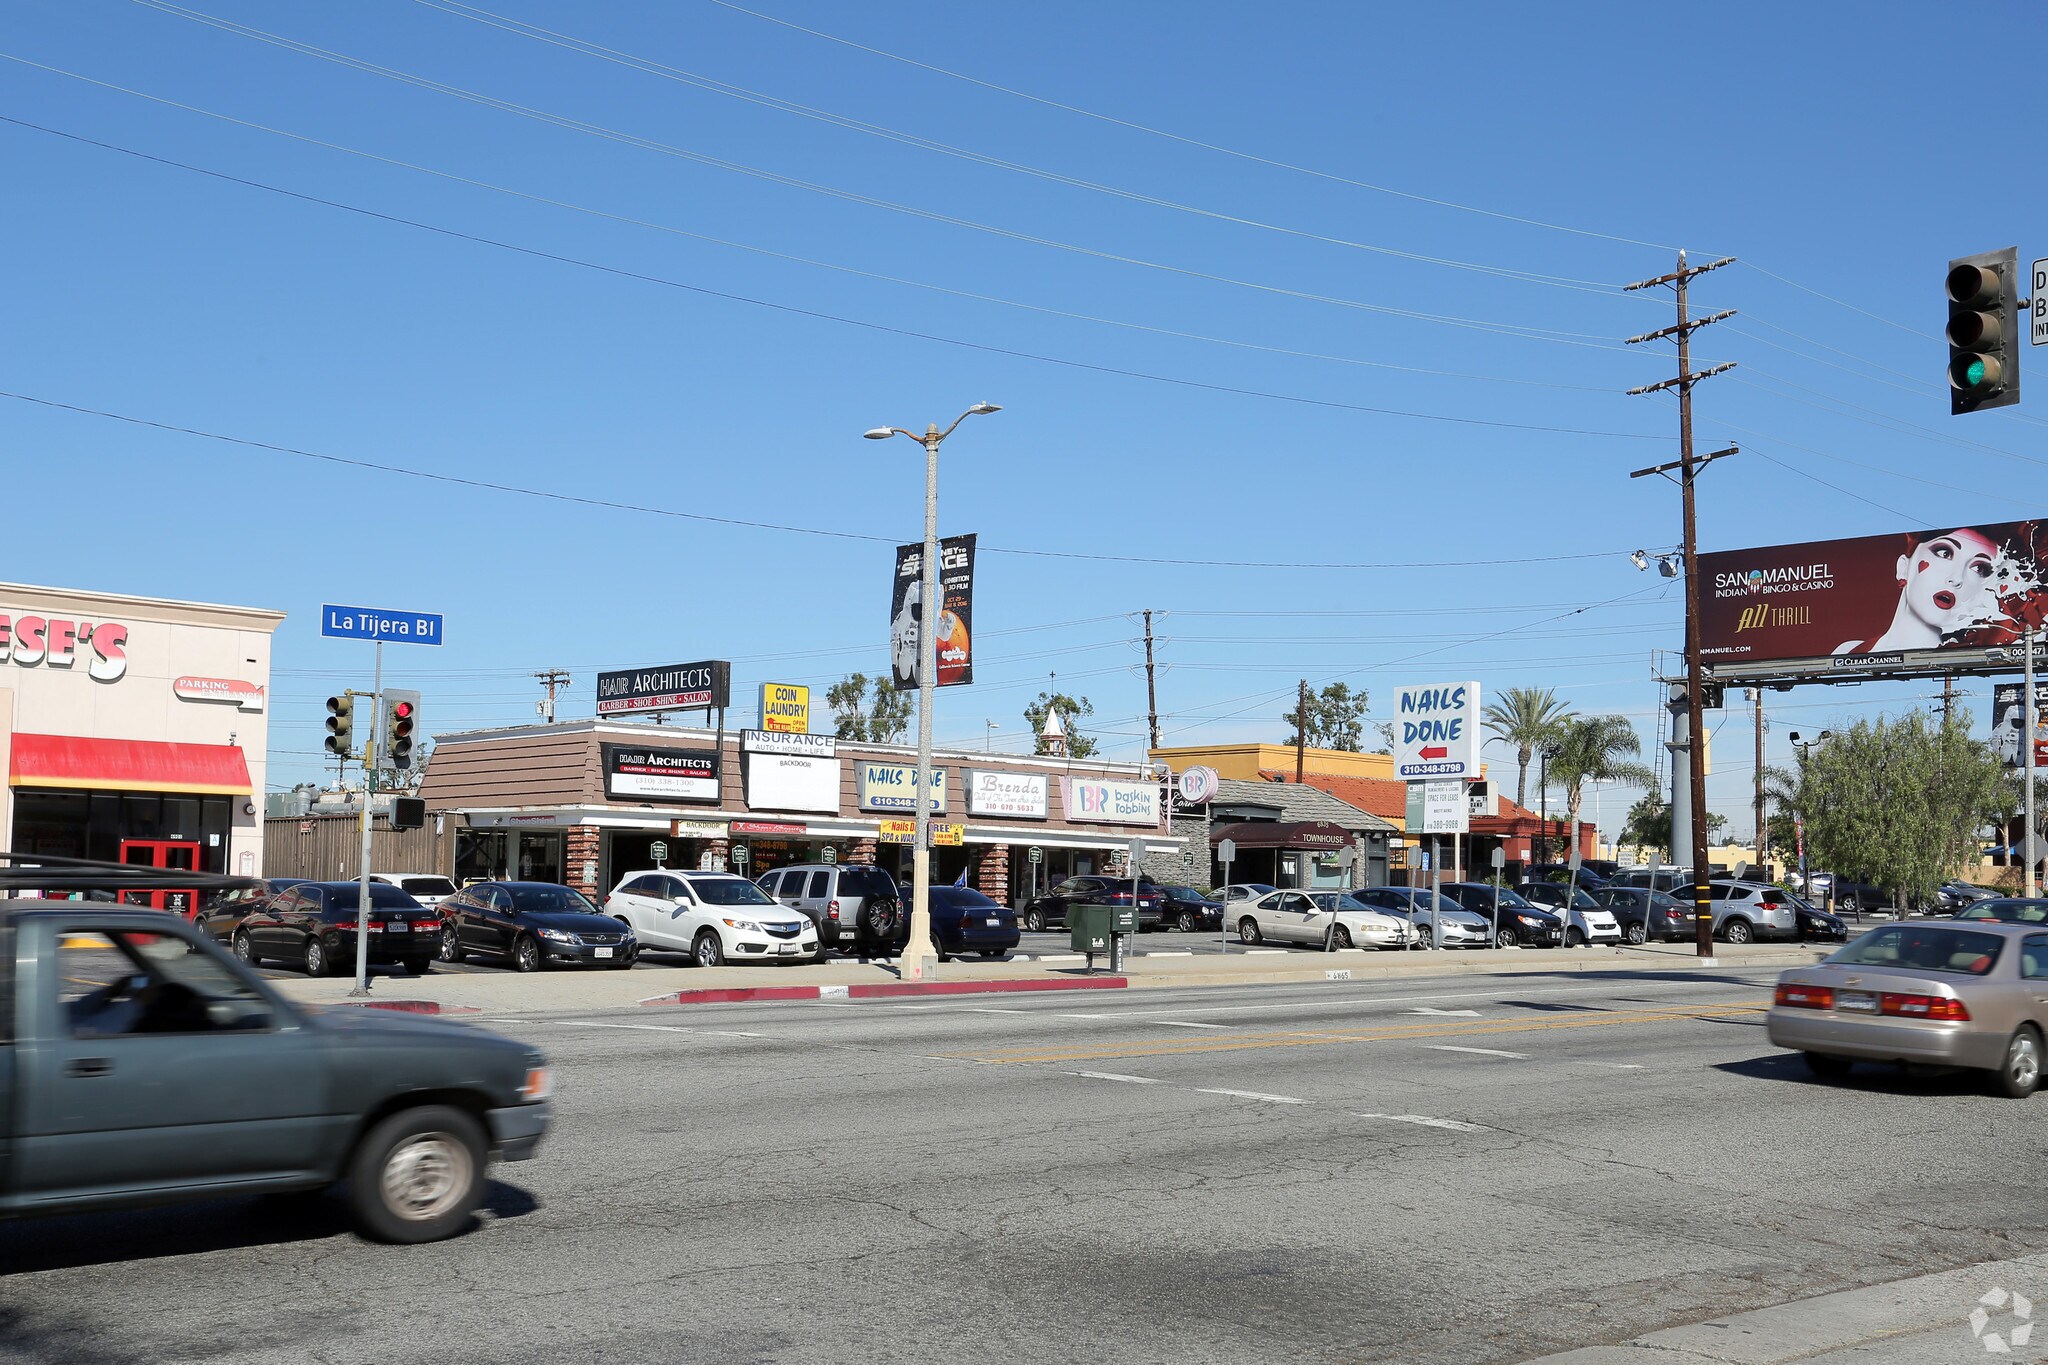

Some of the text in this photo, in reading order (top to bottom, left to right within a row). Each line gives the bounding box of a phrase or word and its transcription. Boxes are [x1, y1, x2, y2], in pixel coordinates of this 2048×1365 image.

[1715, 563, 1834, 588] SAN MANUEL
[1715, 580, 1834, 598] INDIAN BINGO & CASINO
[331, 611, 434, 638] La Tijera Bl
[1771, 606, 1812, 627] THRILL
[179, 680, 228, 690] PARKING
[600, 667, 711, 697] HAIR ARCHITECTS
[601, 692, 709, 711] BARBER SHOE SHINE SALON
[775, 687, 797, 702] COIN
[1401, 687, 1466, 715] NAILS
[765, 702, 806, 717] LAUNDRY
[746, 731, 834, 746] INSURANCE
[1403, 718, 1463, 744] DONE
[755, 744, 775, 752] AUTO
[782, 746, 802, 754] HOME
[620, 753, 712, 769] HAIR ARCHITECTS
[780, 760, 811, 769] BACKDOOR
[1404, 764, 1461, 774] 310-348-8798
[868, 768, 903, 785] NAILS
[980, 774, 1039, 794] Brenda
[1080, 785, 1108, 812] BR
[892, 822, 909, 832] Nails
[882, 833, 894, 841] SPA
[1303, 834, 1344, 843] TOWNHOUSE
